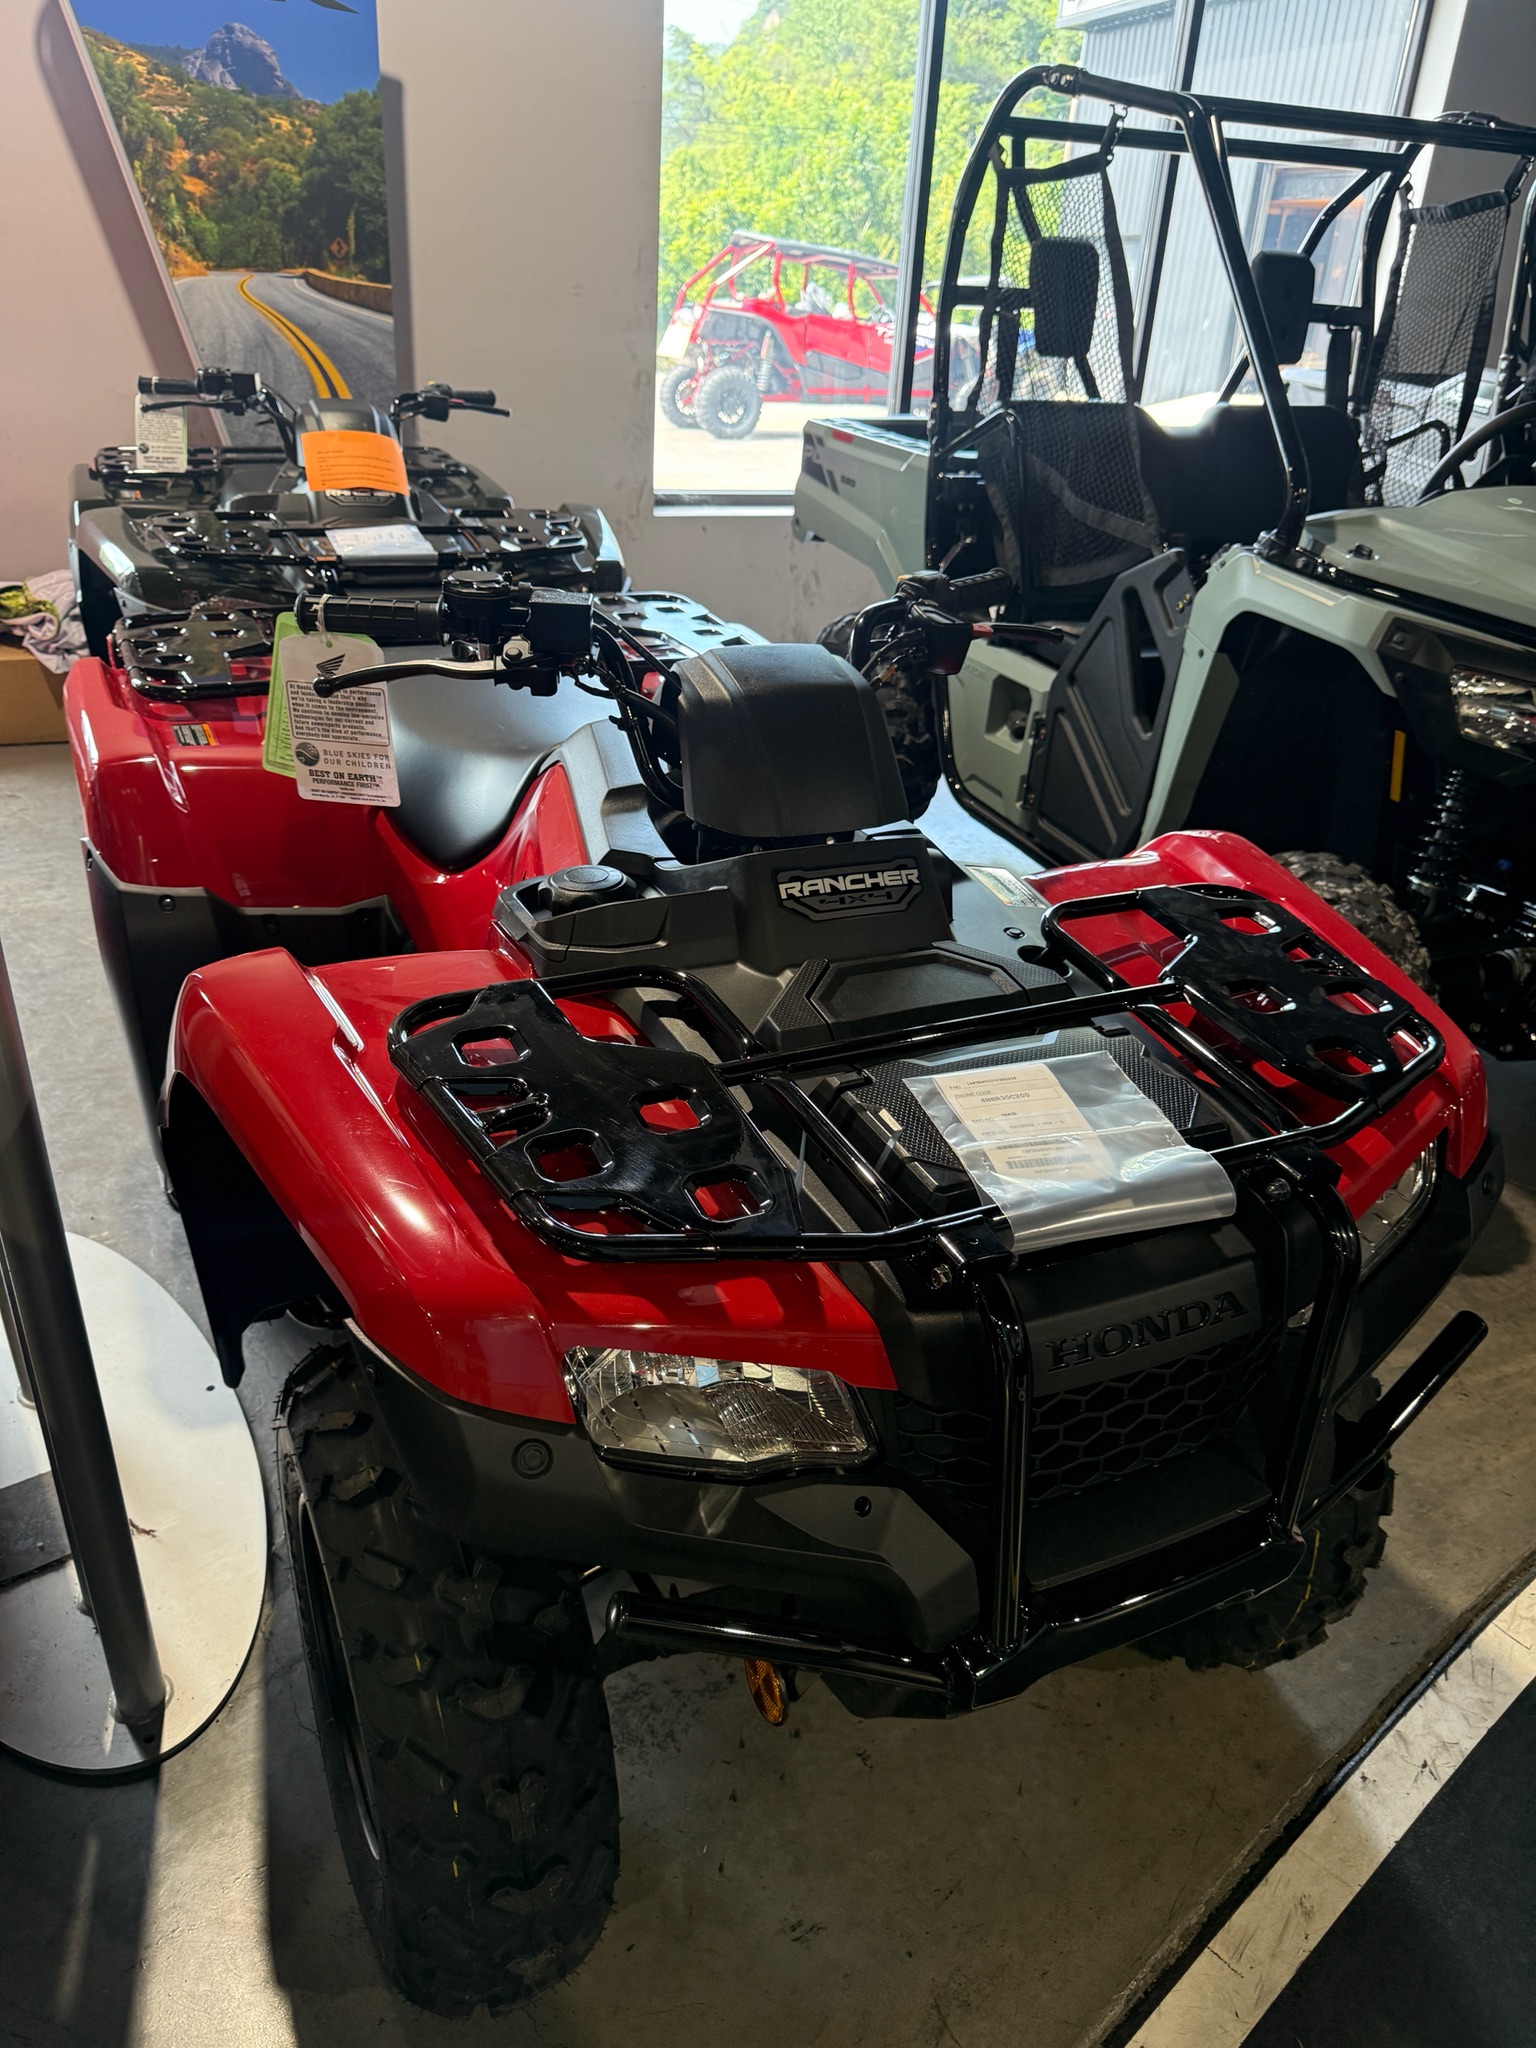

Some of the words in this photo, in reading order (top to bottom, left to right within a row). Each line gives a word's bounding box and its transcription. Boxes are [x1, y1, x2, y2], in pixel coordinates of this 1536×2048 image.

[323, 749, 343, 757] BLUE
[347, 751, 371, 760] SKIES
[324, 758, 342, 766] OUR
[345, 760, 392, 770] CHILDREN
[308, 769, 331, 778] BEST
[333, 772, 345, 780] ON
[312, 777, 356, 788] PERFORMANCE
[778, 869, 921, 899] RANCHER
[1046, 1291, 1249, 1372] HONDA
